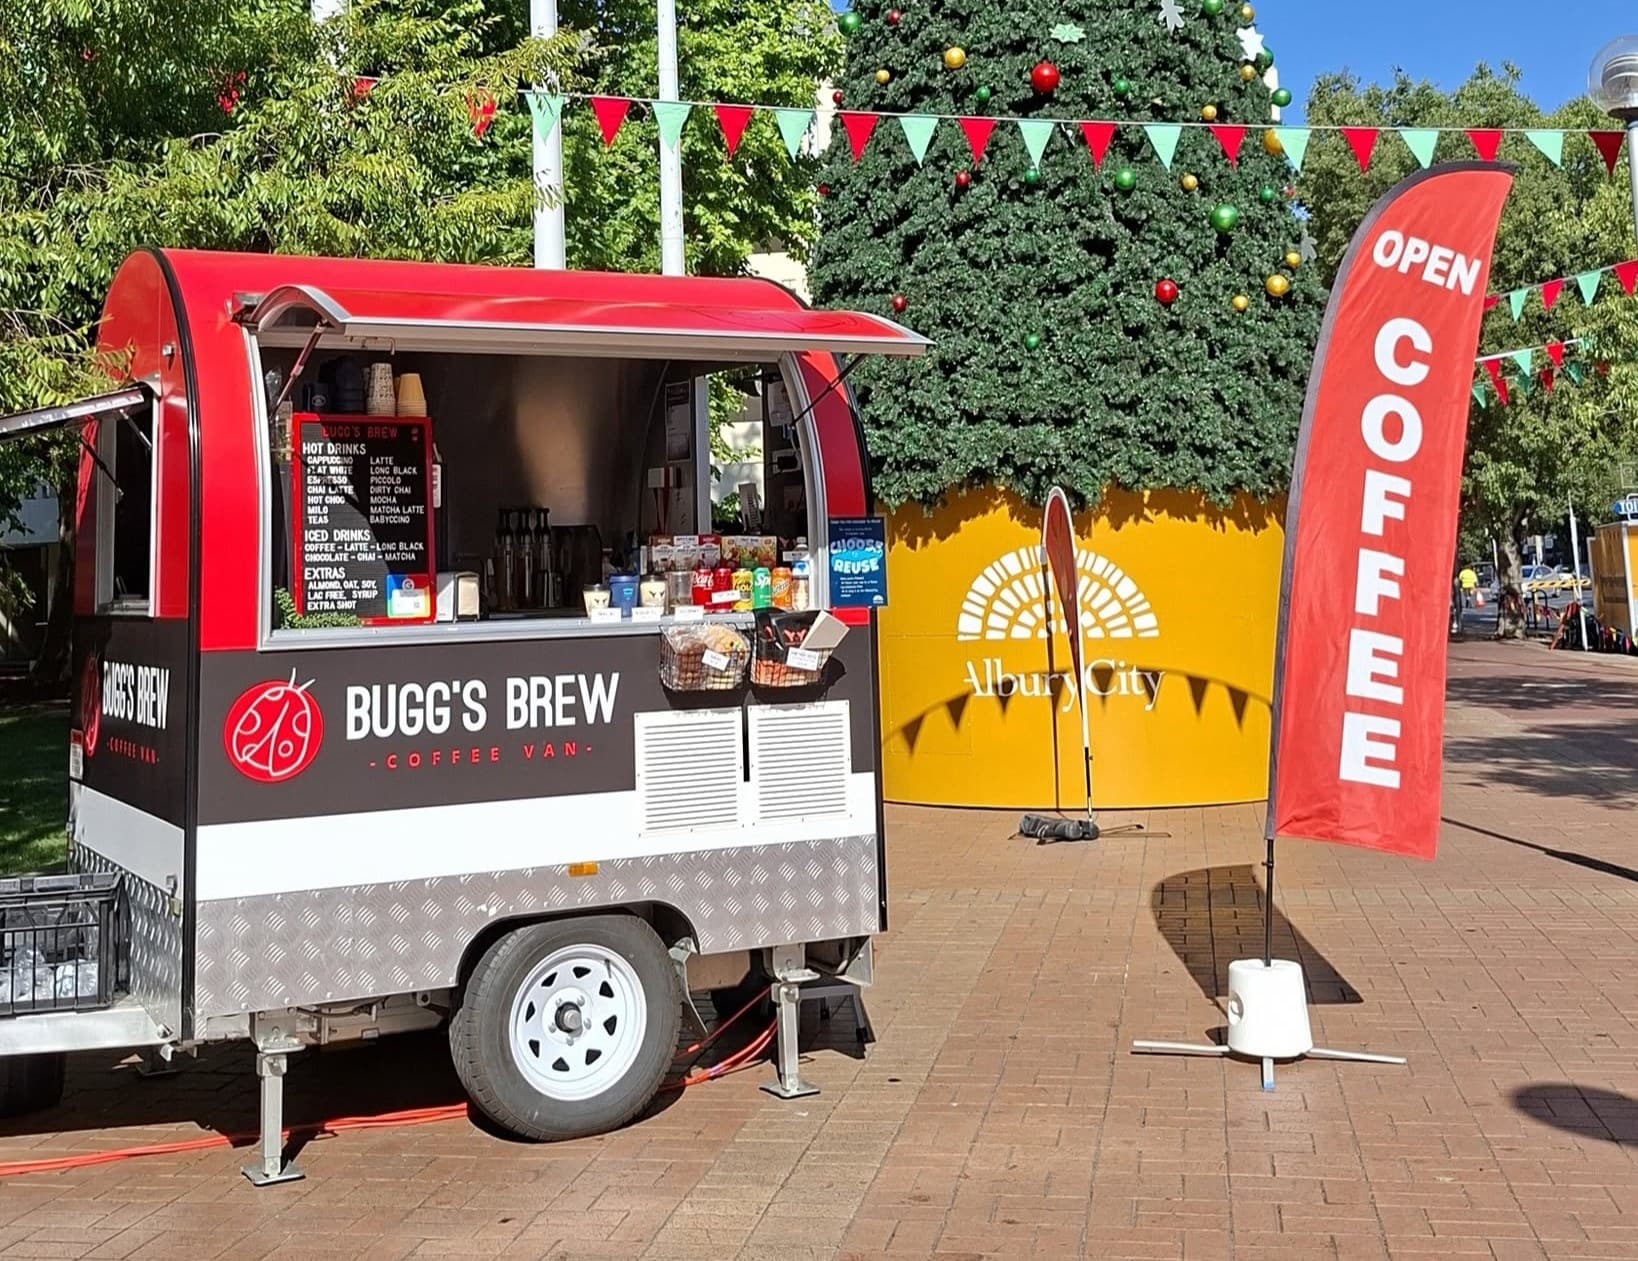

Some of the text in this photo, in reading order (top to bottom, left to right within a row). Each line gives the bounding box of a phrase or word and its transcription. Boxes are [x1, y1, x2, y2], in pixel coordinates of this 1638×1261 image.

[1372, 230, 1482, 295] OPEN
[368, 426, 398, 438] BREW
[303, 443, 367, 455] HOT DRINKS
[370, 456, 394, 465] LATTE
[329, 466, 353, 475] WHITE
[370, 466, 417, 475] LONG BLACK
[307, 476, 348, 484] ESPRESSO
[370, 476, 401, 484] PICCOLO
[307, 486, 354, 494] CHAI LATTE
[370, 486, 411, 494] DIRTY CHAI
[307, 496, 324, 504] HOT
[370, 496, 397, 504] MOCHA
[307, 506, 329, 514] MILO
[370, 506, 424, 514] MATCHA LATTE
[308, 516, 329, 524] TEAS
[370, 516, 410, 524] BABYCCINO
[304, 529, 370, 541] ICED DRINKS
[304, 543, 336, 552] COFFEE
[344, 543, 368, 551] LATTE
[376, 543, 396, 551] LONG
[399, 542, 424, 550] BLACK
[304, 553, 349, 562] CHOCOLATE
[357, 553, 376, 561] CHAI
[385, 553, 416, 561] MATCHA
[1340, 317, 1432, 789] COFFEE
[833, 557, 880, 574] REUSE
[304, 567, 346, 580] EXTRAS
[352, 590, 378, 599] SYRUP
[307, 600, 356, 610] EXTRA SHOT
[102, 661, 169, 730] BUGG'S BREW
[346, 672, 620, 740] BUGG'S BREW
